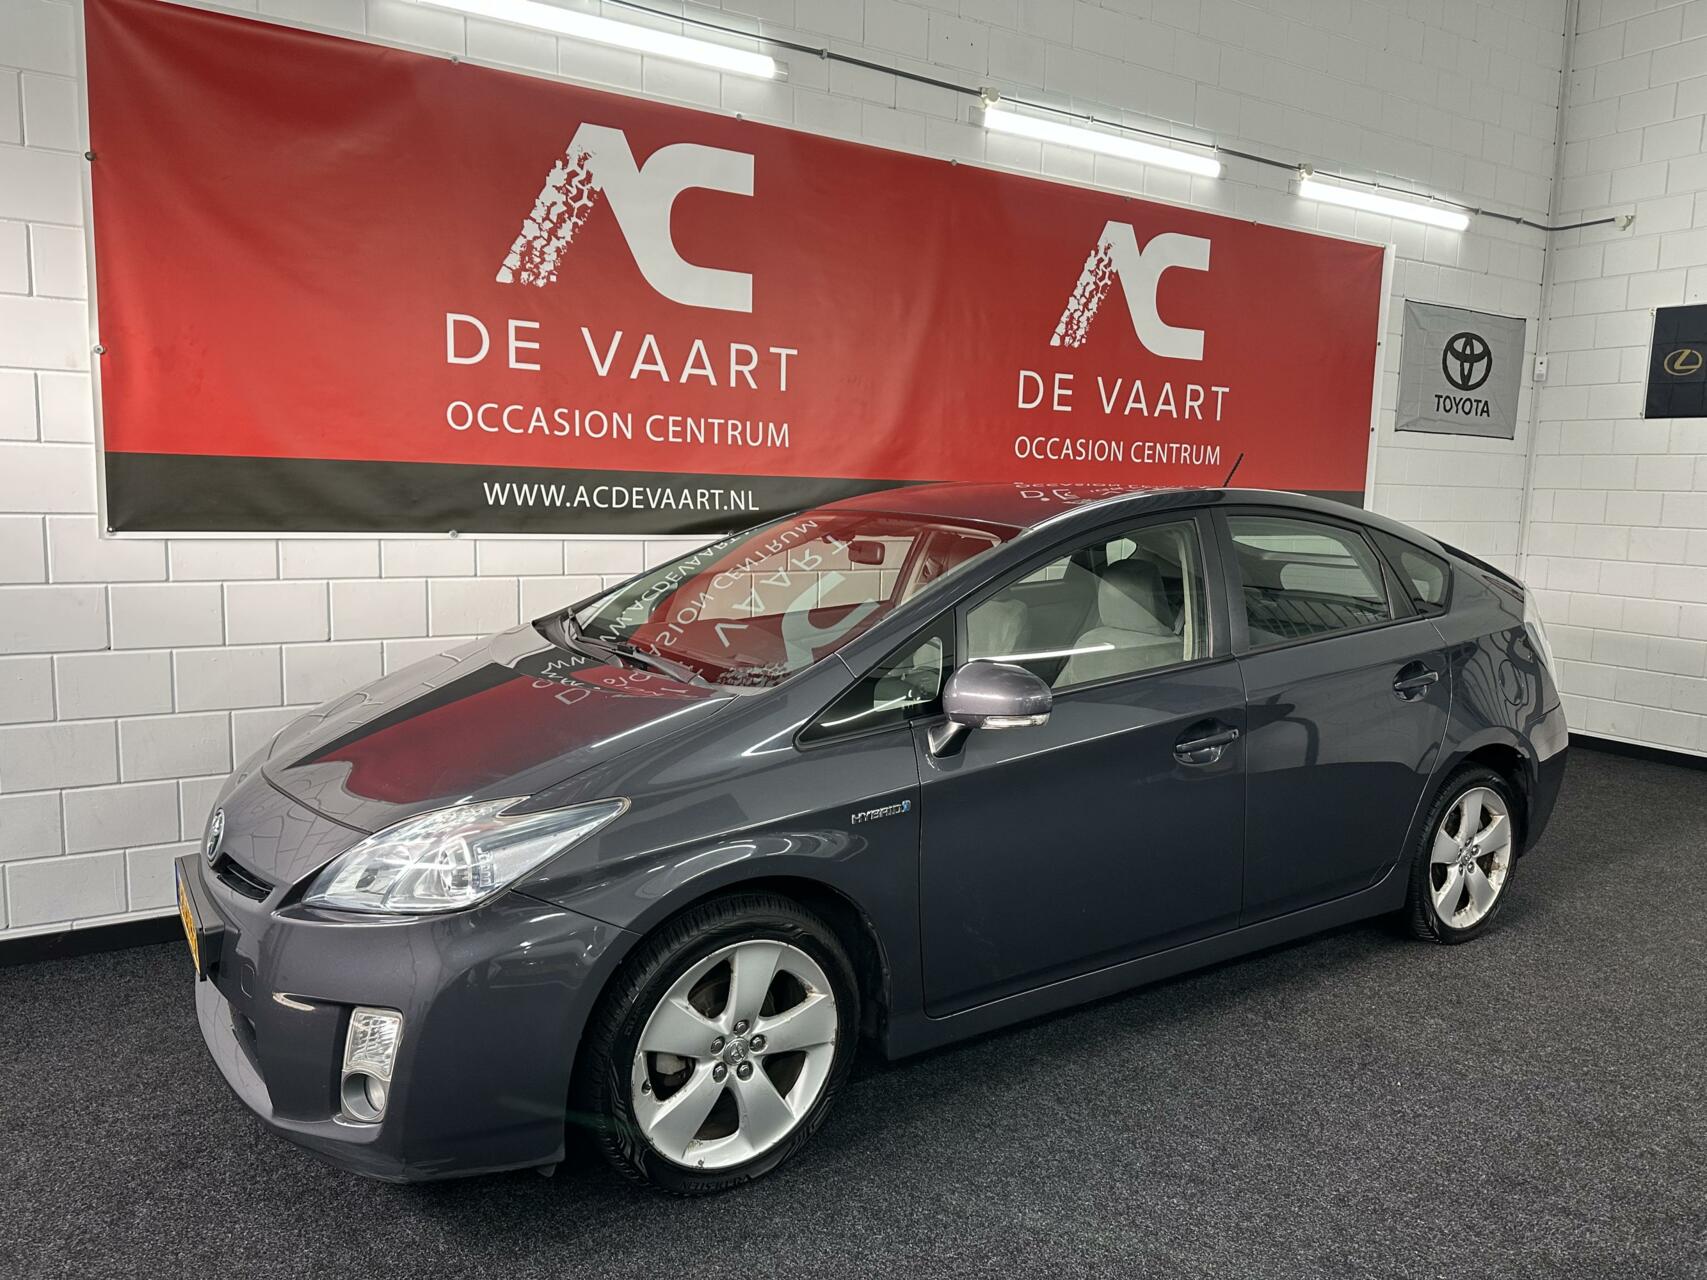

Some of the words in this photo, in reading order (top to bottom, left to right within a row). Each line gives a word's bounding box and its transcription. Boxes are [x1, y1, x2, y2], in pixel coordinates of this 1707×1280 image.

[496, 122, 755, 313] AC
[1050, 220, 1211, 360] AC
[446, 313, 541, 371] DE
[580, 326, 798, 391] VAART
[1017, 370, 1074, 412] DE
[1097, 376, 1230, 421] VAART
[1434, 394, 1490, 418] TOYOTA
[446, 401, 633, 440] OCCASION
[645, 414, 790, 448] CENTRUM
[1014, 435, 1123, 462] OCCASION
[1130, 441, 1221, 465] CENTRUM
[483, 482, 760, 511] WWW.ACDEVAART.NL
[851, 803, 905, 824] HYBRID
